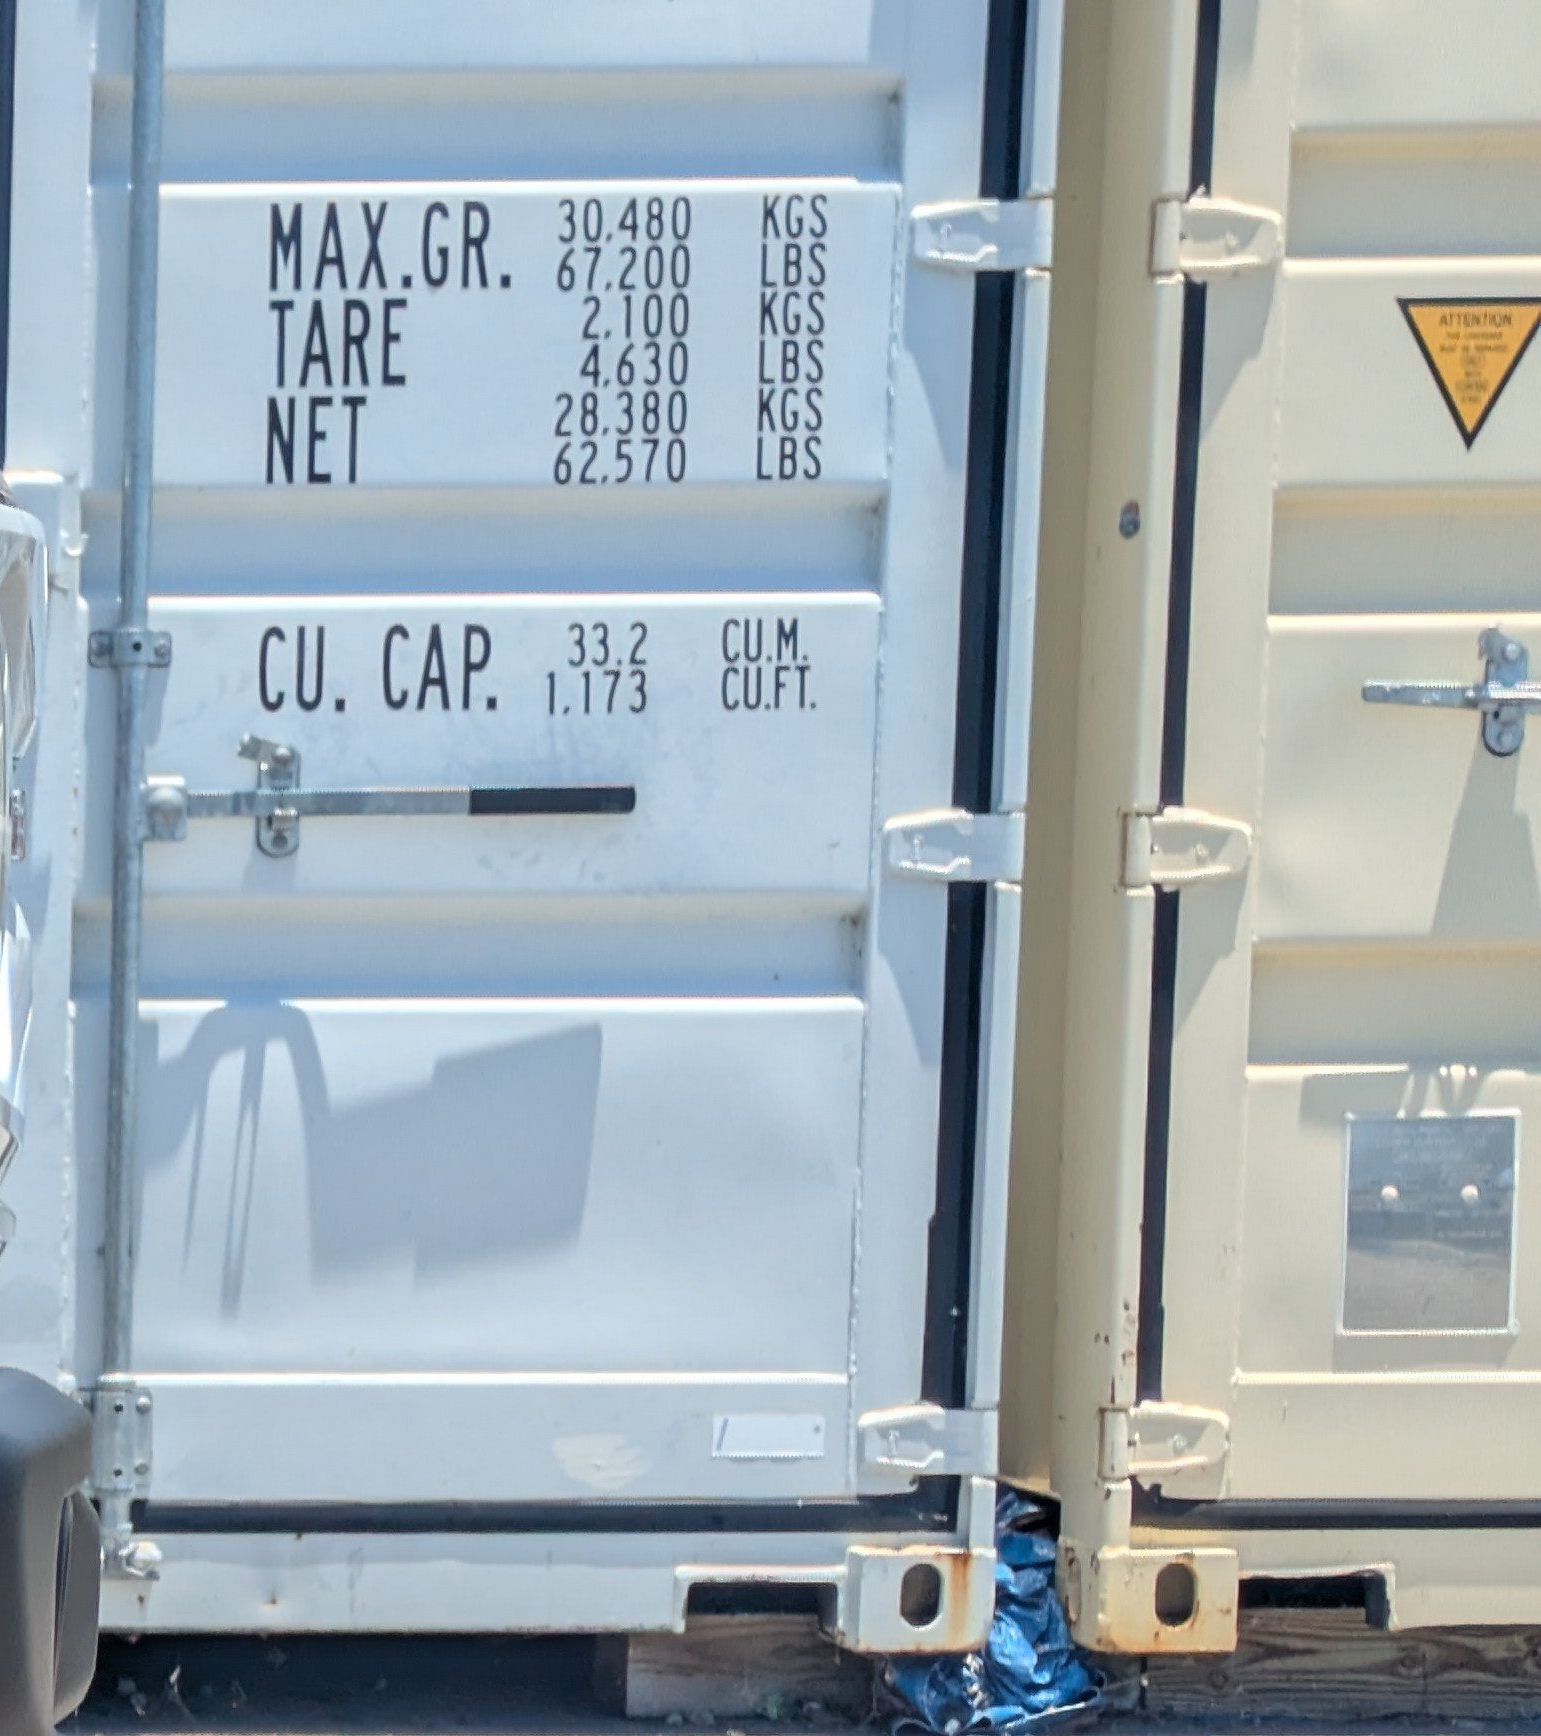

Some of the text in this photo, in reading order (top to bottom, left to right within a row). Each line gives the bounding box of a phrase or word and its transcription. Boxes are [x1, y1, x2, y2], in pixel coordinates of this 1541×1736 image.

[269, 201, 512, 291] MAX.GR.
[761, 194, 828, 240] KGS
[760, 242, 826, 289] LBS
[269, 298, 408, 388] TARE
[759, 290, 825, 337] KGS
[1438, 312, 1512, 327] ATTENTION
[758, 338, 824, 385] LBS
[265, 396, 367, 485] NET
[757, 387, 823, 434] KGS
[755, 436, 822, 481] LBS
[258, 625, 347, 713] CU.
[382, 623, 499, 711] CAP.
[567, 621, 648, 667] 33.2
